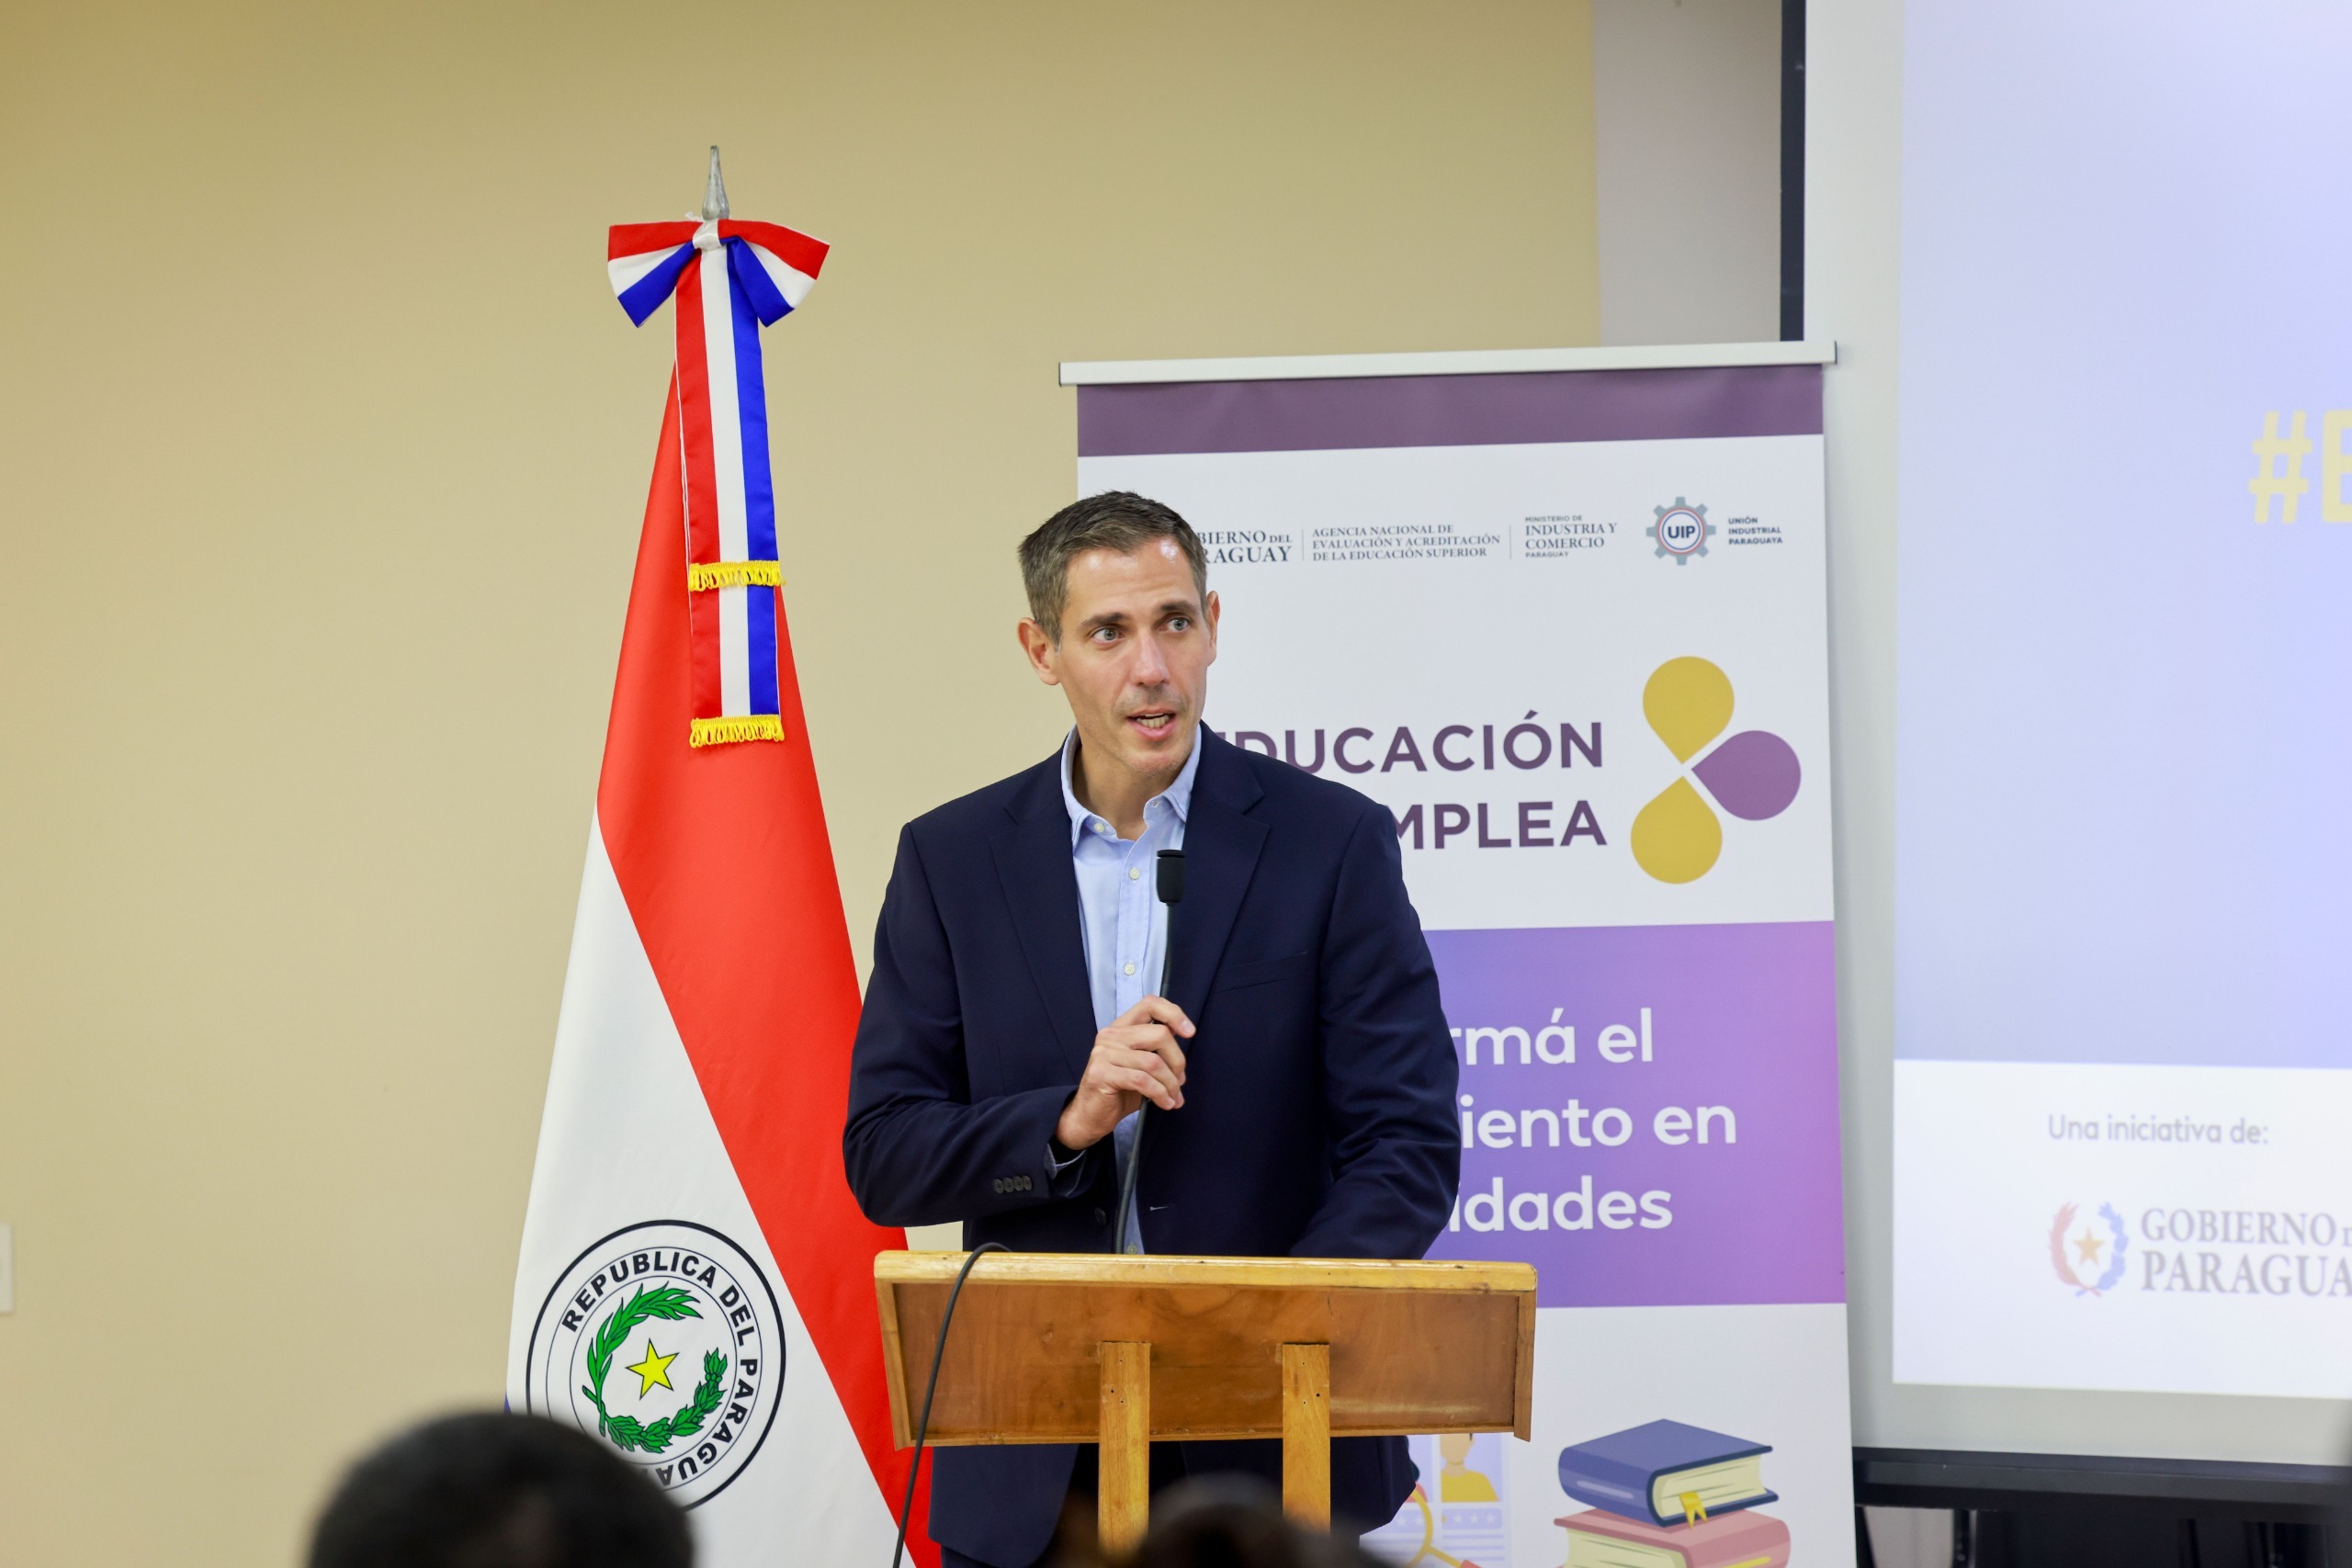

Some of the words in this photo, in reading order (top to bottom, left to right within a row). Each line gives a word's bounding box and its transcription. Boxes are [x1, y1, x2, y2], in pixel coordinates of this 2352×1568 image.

[1728, 515, 1758, 525] UNIÓN
[1312, 526, 1367, 537] AGENCIA
[1370, 525, 1435, 536] NACIONAL
[1438, 525, 1453, 534] DE
[1525, 524, 1605, 536] INDUSTRIA
[1608, 523, 1617, 534] Y
[1668, 525, 1696, 539] UIP
[1270, 535, 1293, 543] DEL
[1313, 536, 1393, 549] EVALUACIÓN
[1396, 537, 1404, 547] Y
[1406, 534, 1500, 547] ACREDITACIÓN
[1525, 537, 1605, 549] COMERCIO
[1728, 536, 1783, 545] PARAGUAYA
[1313, 552, 1329, 561] DE
[1331, 551, 1346, 560] LA
[1350, 548, 1424, 559] EDUCACIÓN
[1426, 547, 1487, 558] SUPERIOR
[1215, 710, 1603, 774] DUCACIÓN
[1598, 1008, 1653, 1063] el
[1653, 1104, 1736, 1145] en
[2048, 1113, 2100, 1141] Una
[2108, 1112, 2222, 1144] iniciativa
[2230, 1117, 2269, 1145] de:
[2141, 1208, 2336, 1247] GOBIERNO
[561, 1251, 717, 1332] REPUBLICA
[718, 1284, 755, 1347] DEL
